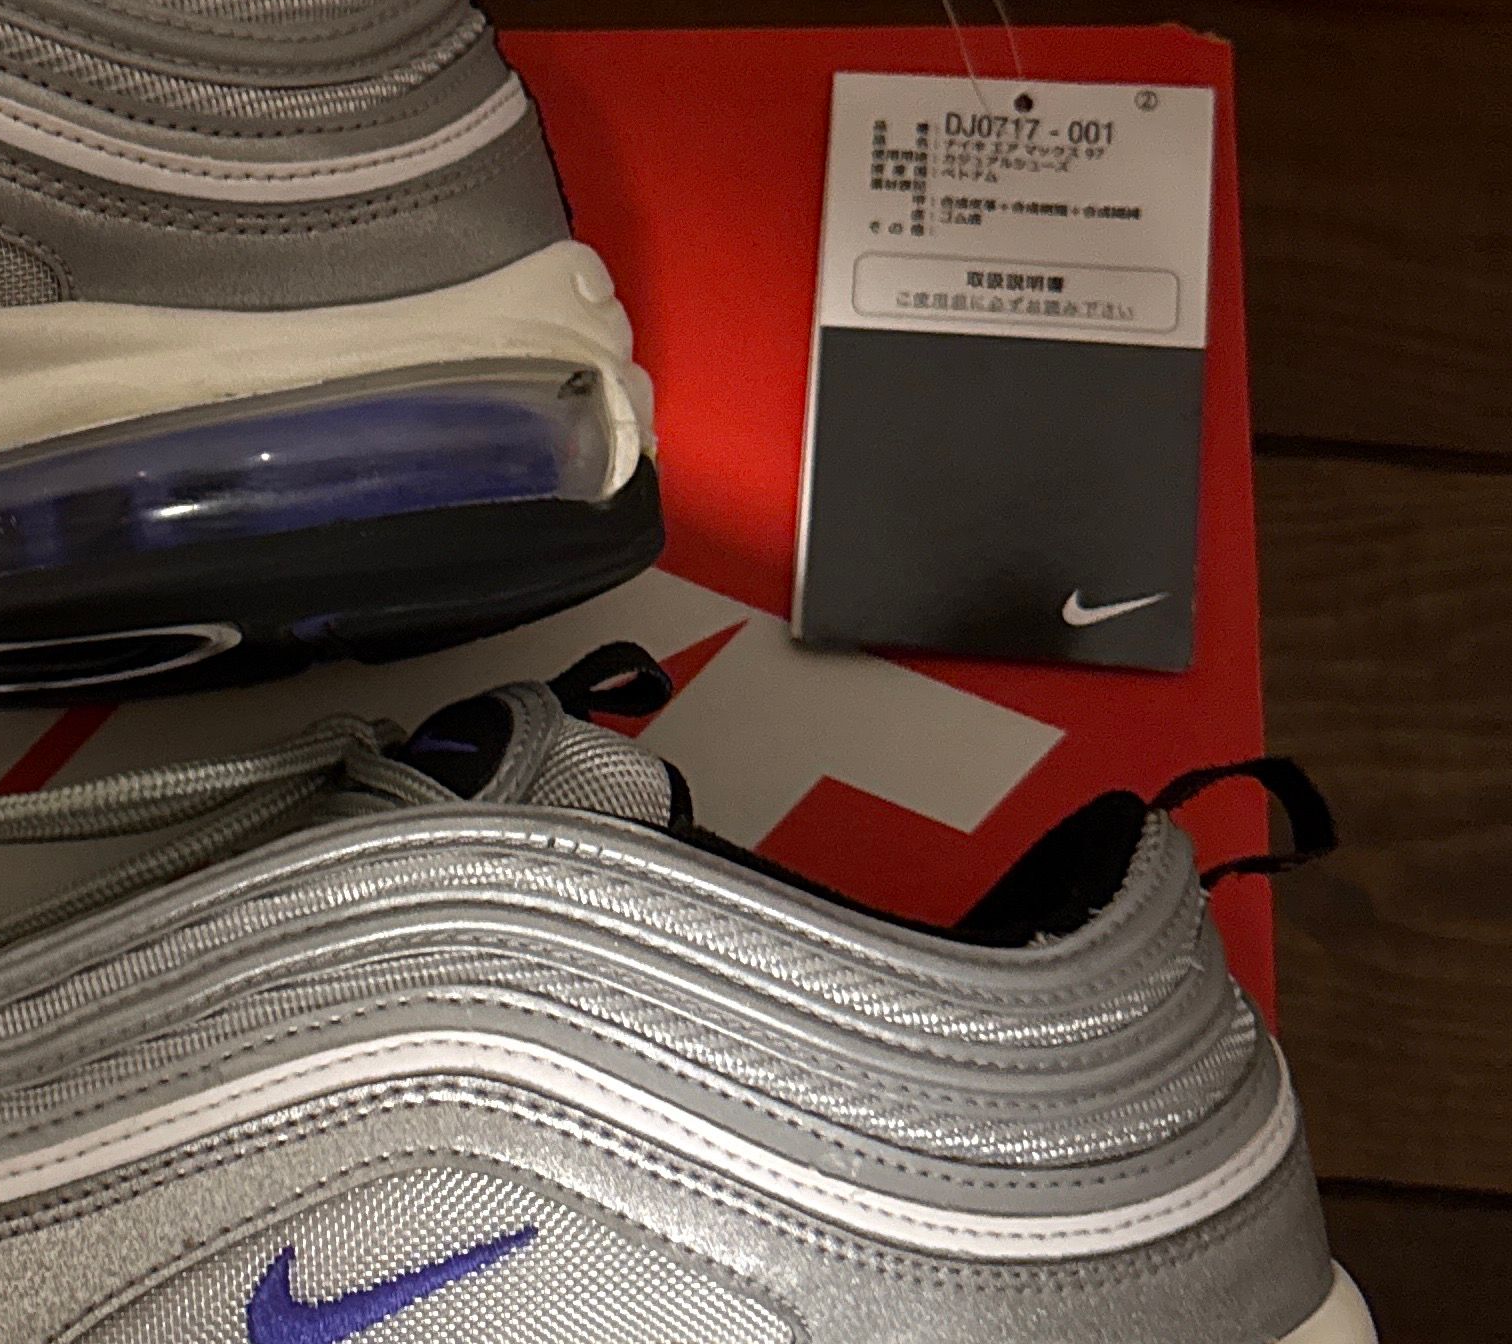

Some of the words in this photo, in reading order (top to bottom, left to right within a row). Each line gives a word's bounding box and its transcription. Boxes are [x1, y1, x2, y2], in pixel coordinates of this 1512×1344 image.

[967, 271, 1064, 293] 取扱説明書
